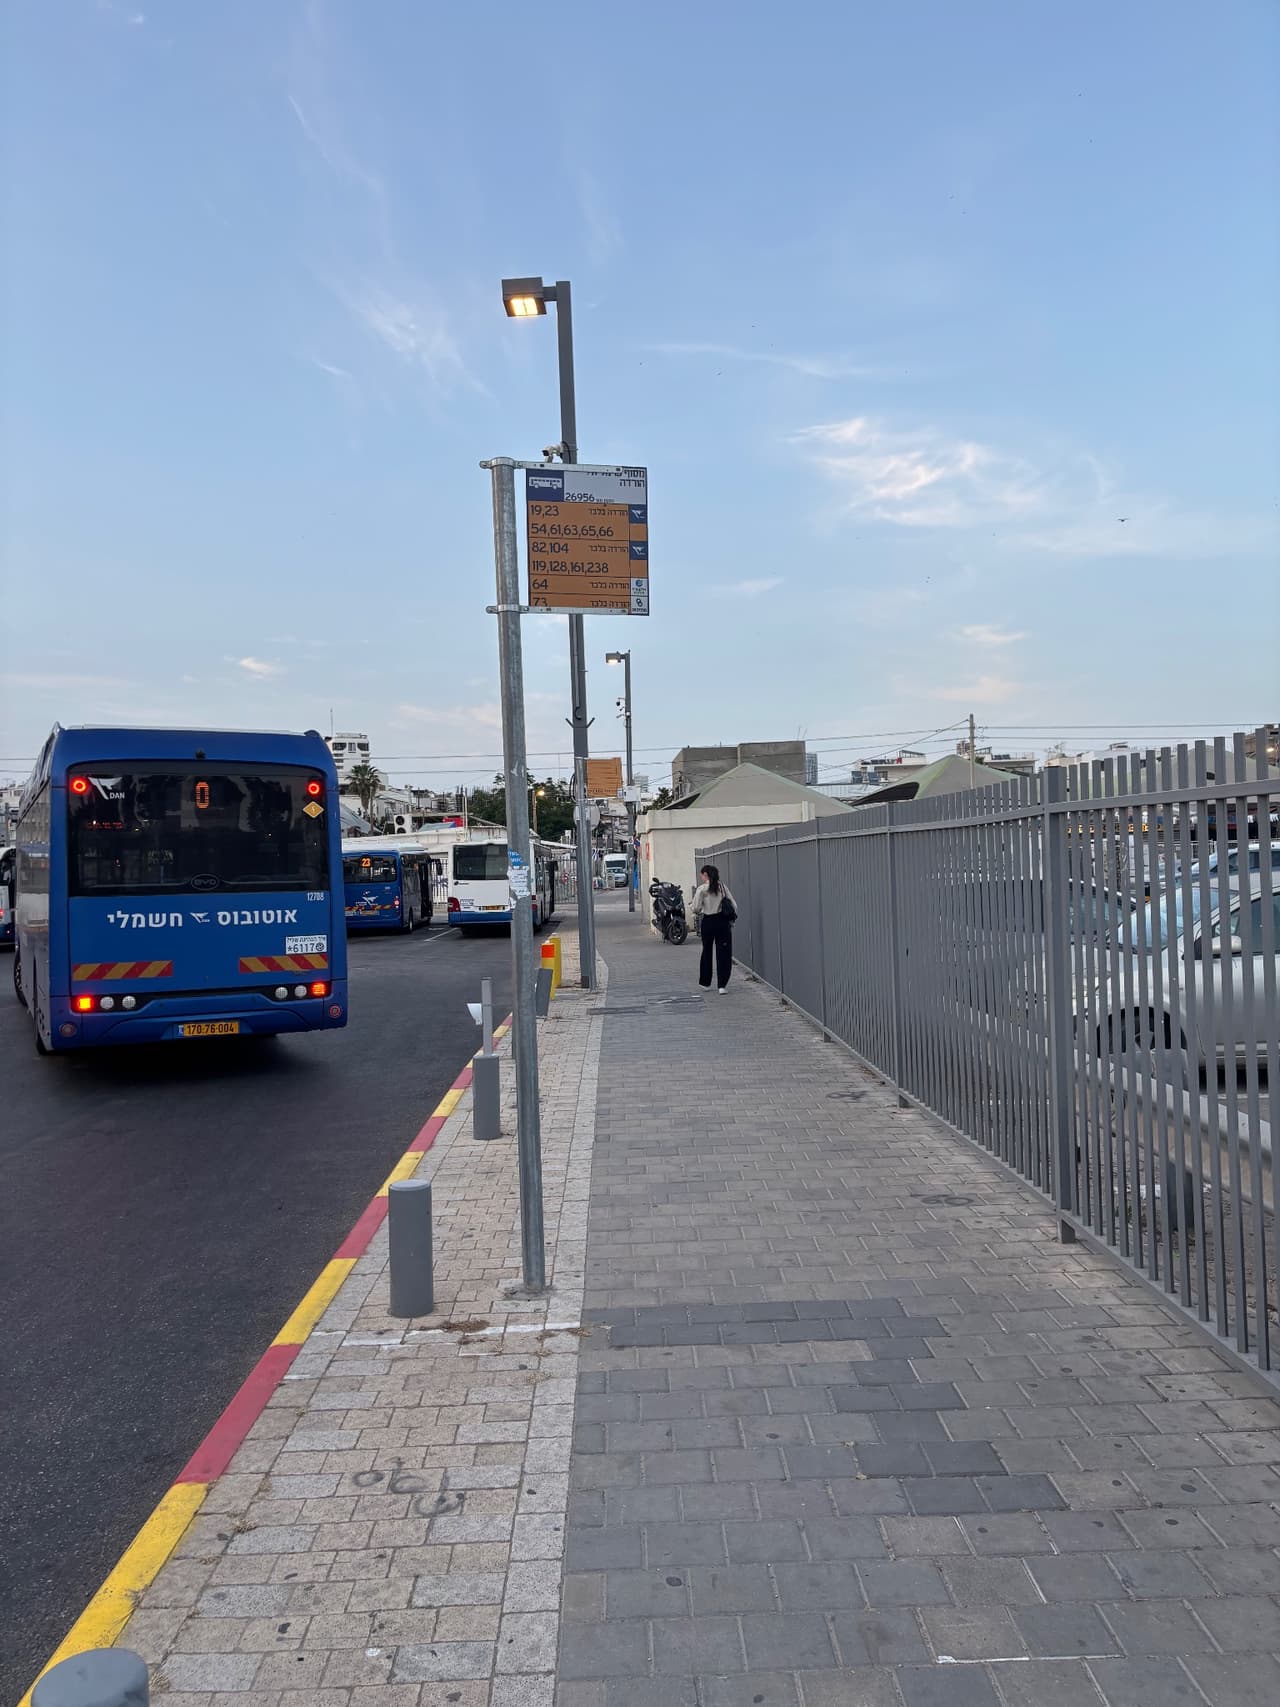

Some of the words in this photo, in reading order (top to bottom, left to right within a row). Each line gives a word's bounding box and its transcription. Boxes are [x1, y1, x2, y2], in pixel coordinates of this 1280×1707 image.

[565, 492, 595, 502] 26956
[530, 504, 559, 518] 19,23
[530, 523, 614, 537] 54,61,63,65,66
[531, 542, 569, 555] 82,104
[532, 560, 609, 575] 119,128,161,238
[532, 579, 548, 590] 64
[533, 597, 547, 606] 73
[109, 791, 125, 800] DAN
[195, 781, 210, 809] 0
[360, 857, 371, 867] 23
[107, 911, 183, 929] חשמלי
[217, 909, 298, 926] אוטובוס
